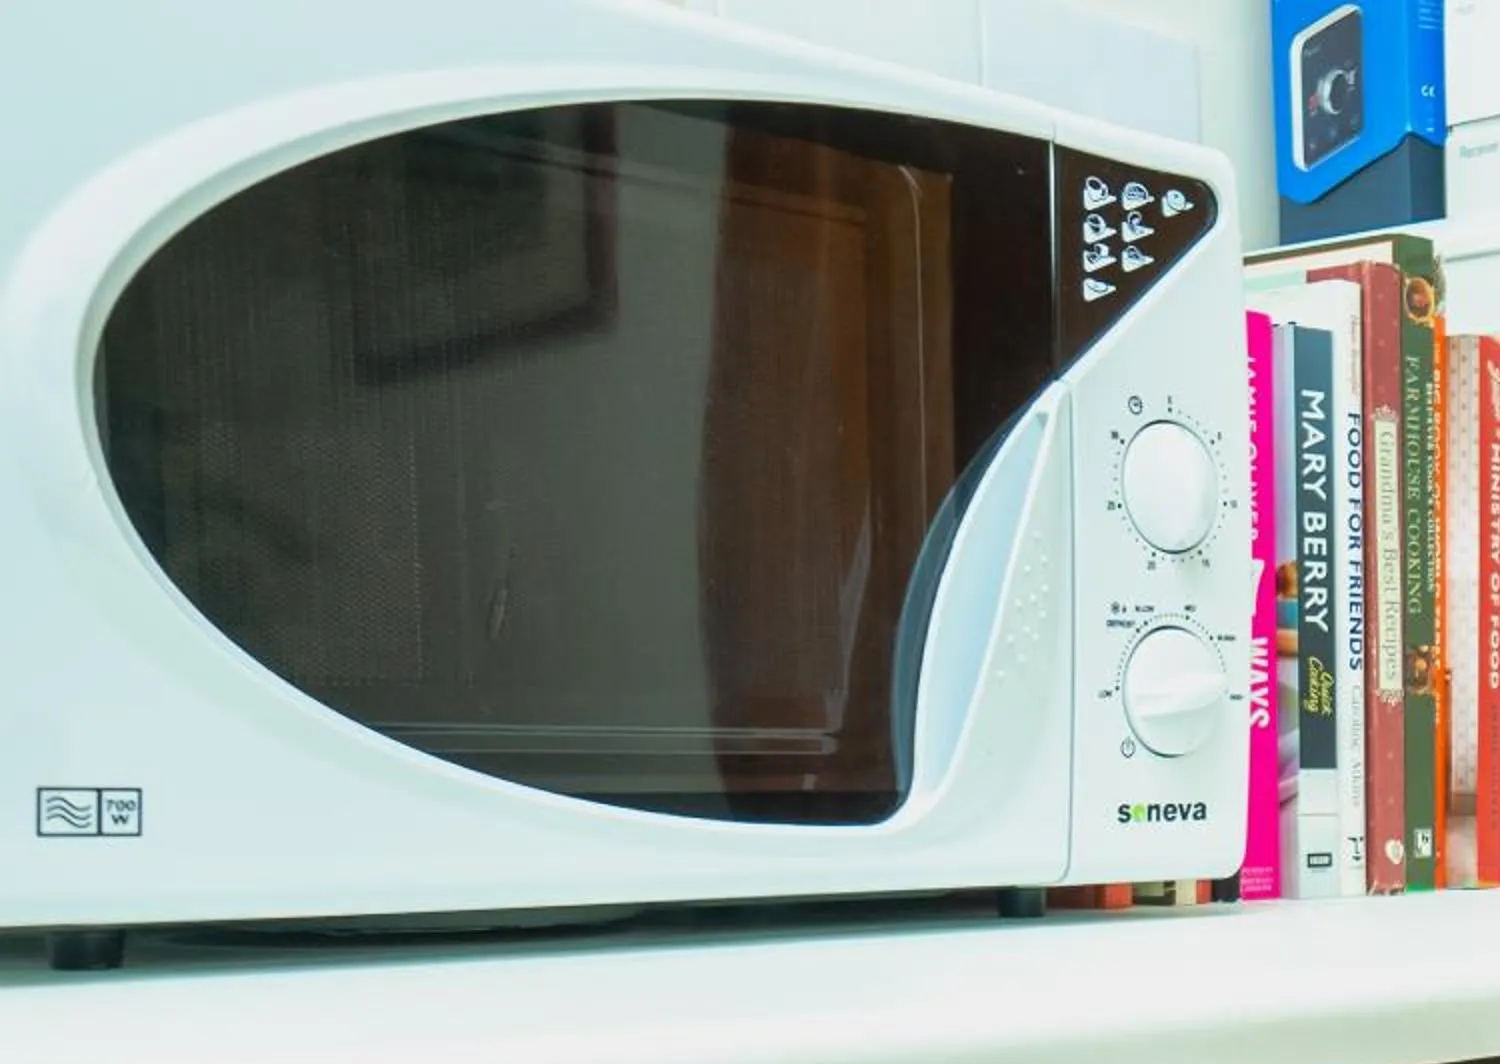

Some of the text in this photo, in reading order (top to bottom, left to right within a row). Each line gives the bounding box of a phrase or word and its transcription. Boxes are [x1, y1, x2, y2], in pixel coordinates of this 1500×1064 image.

[1301, 389, 1329, 633] MARY BERRY
[1346, 412, 1365, 671] FOOD FOR FRIENDS
[1378, 430, 1400, 680] Grandma's Best Recipes
[1404, 355, 1422, 614] FARMHOUSE COOKING
[1490, 442, 1500, 560] MINISTRY
[1488, 615, 1500, 689] FOOD
[1490, 572, 1500, 606] OF
[111, 814, 130, 825] W
